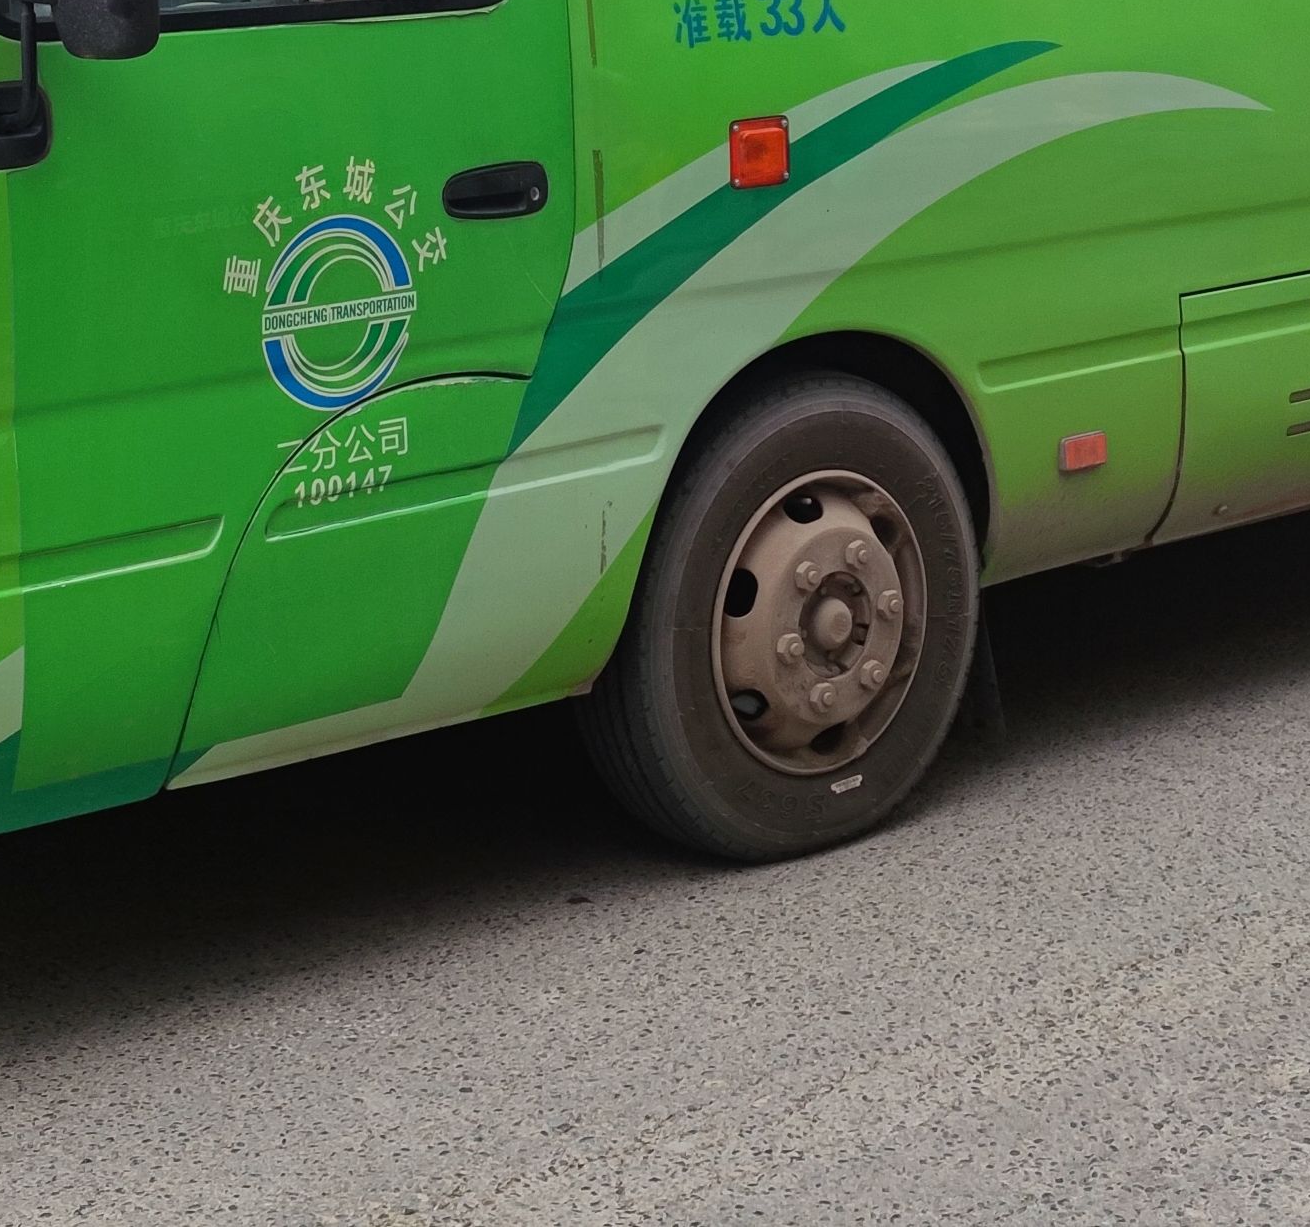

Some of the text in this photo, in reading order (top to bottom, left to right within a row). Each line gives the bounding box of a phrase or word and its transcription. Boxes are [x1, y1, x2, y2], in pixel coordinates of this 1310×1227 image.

[222, 155, 448, 298] 重庆东城公交
[264, 294, 416, 332] DONGCHENG TRANSPORTATION
[274, 416, 409, 475] 二分公司
[293, 464, 393, 509] 100147
